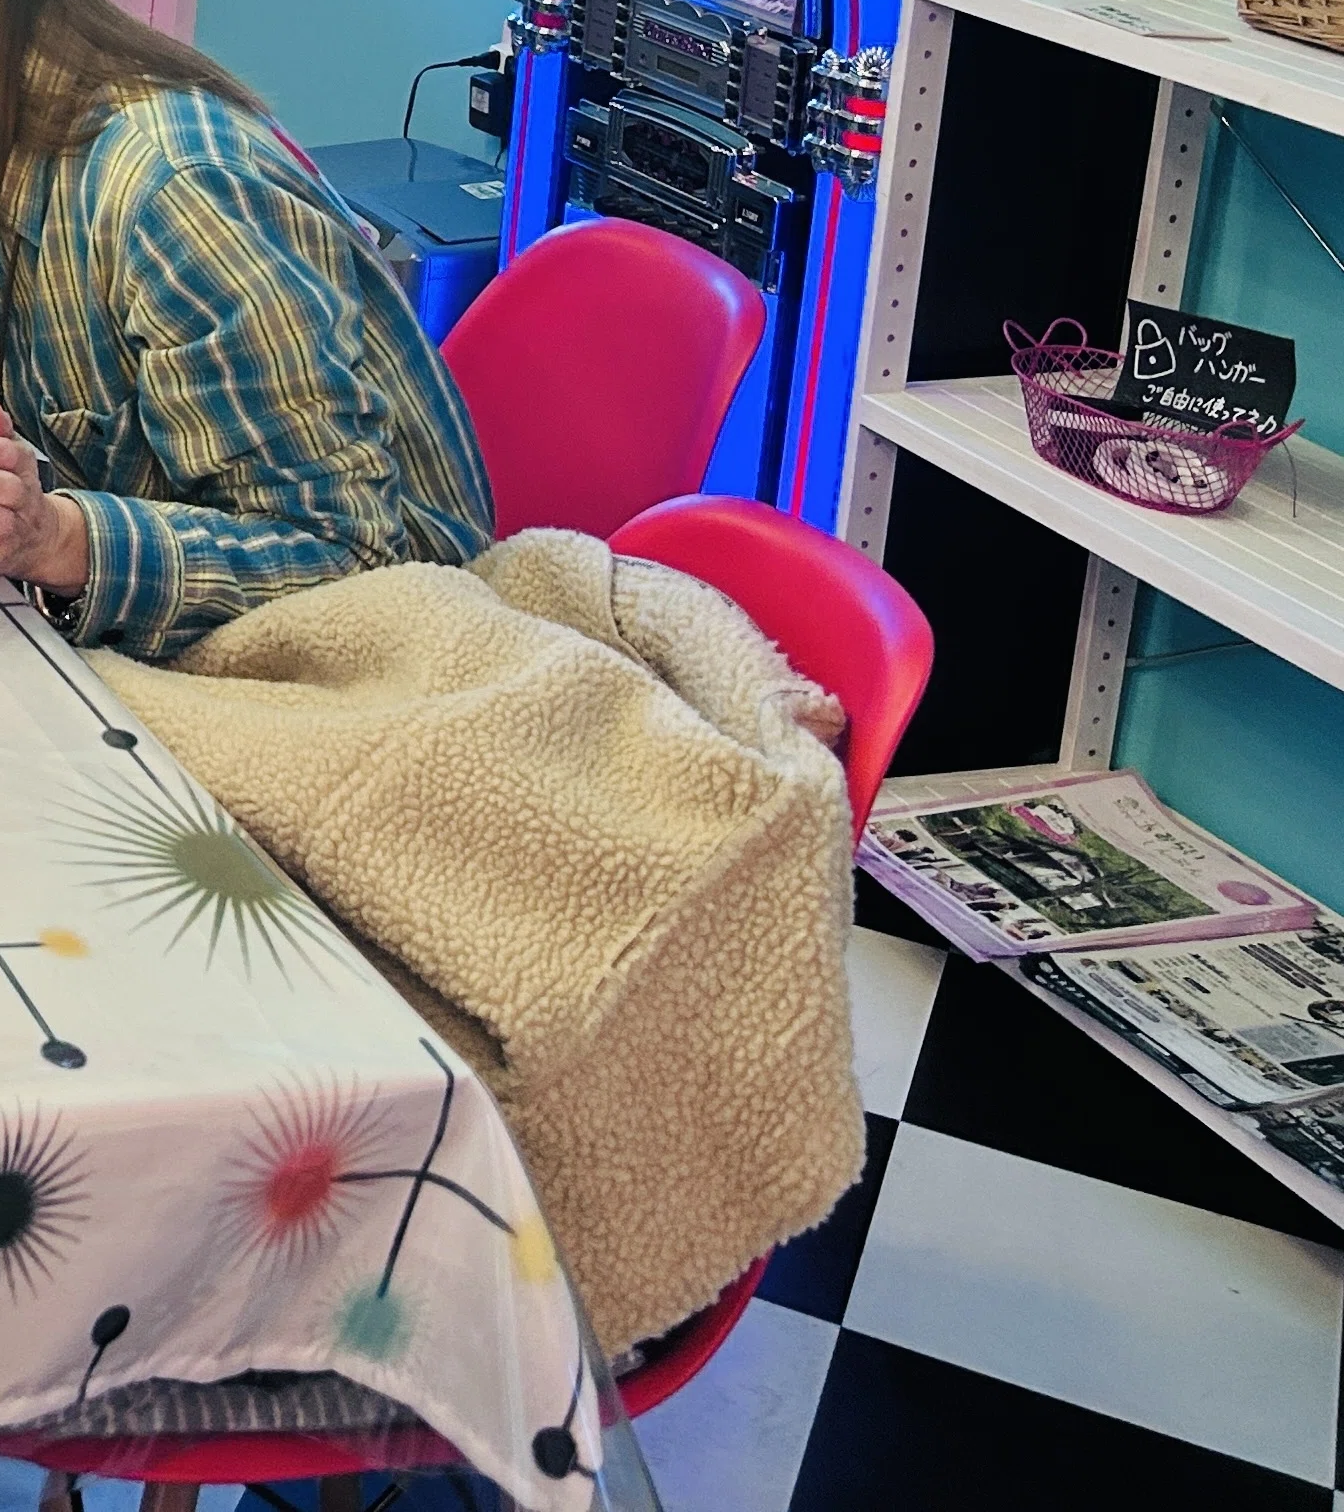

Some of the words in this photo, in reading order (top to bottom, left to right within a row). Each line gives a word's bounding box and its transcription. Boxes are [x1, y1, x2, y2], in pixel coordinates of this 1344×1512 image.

[1178, 323, 1233, 356] バッグ
[1193, 357, 1267, 385] ハンガー
